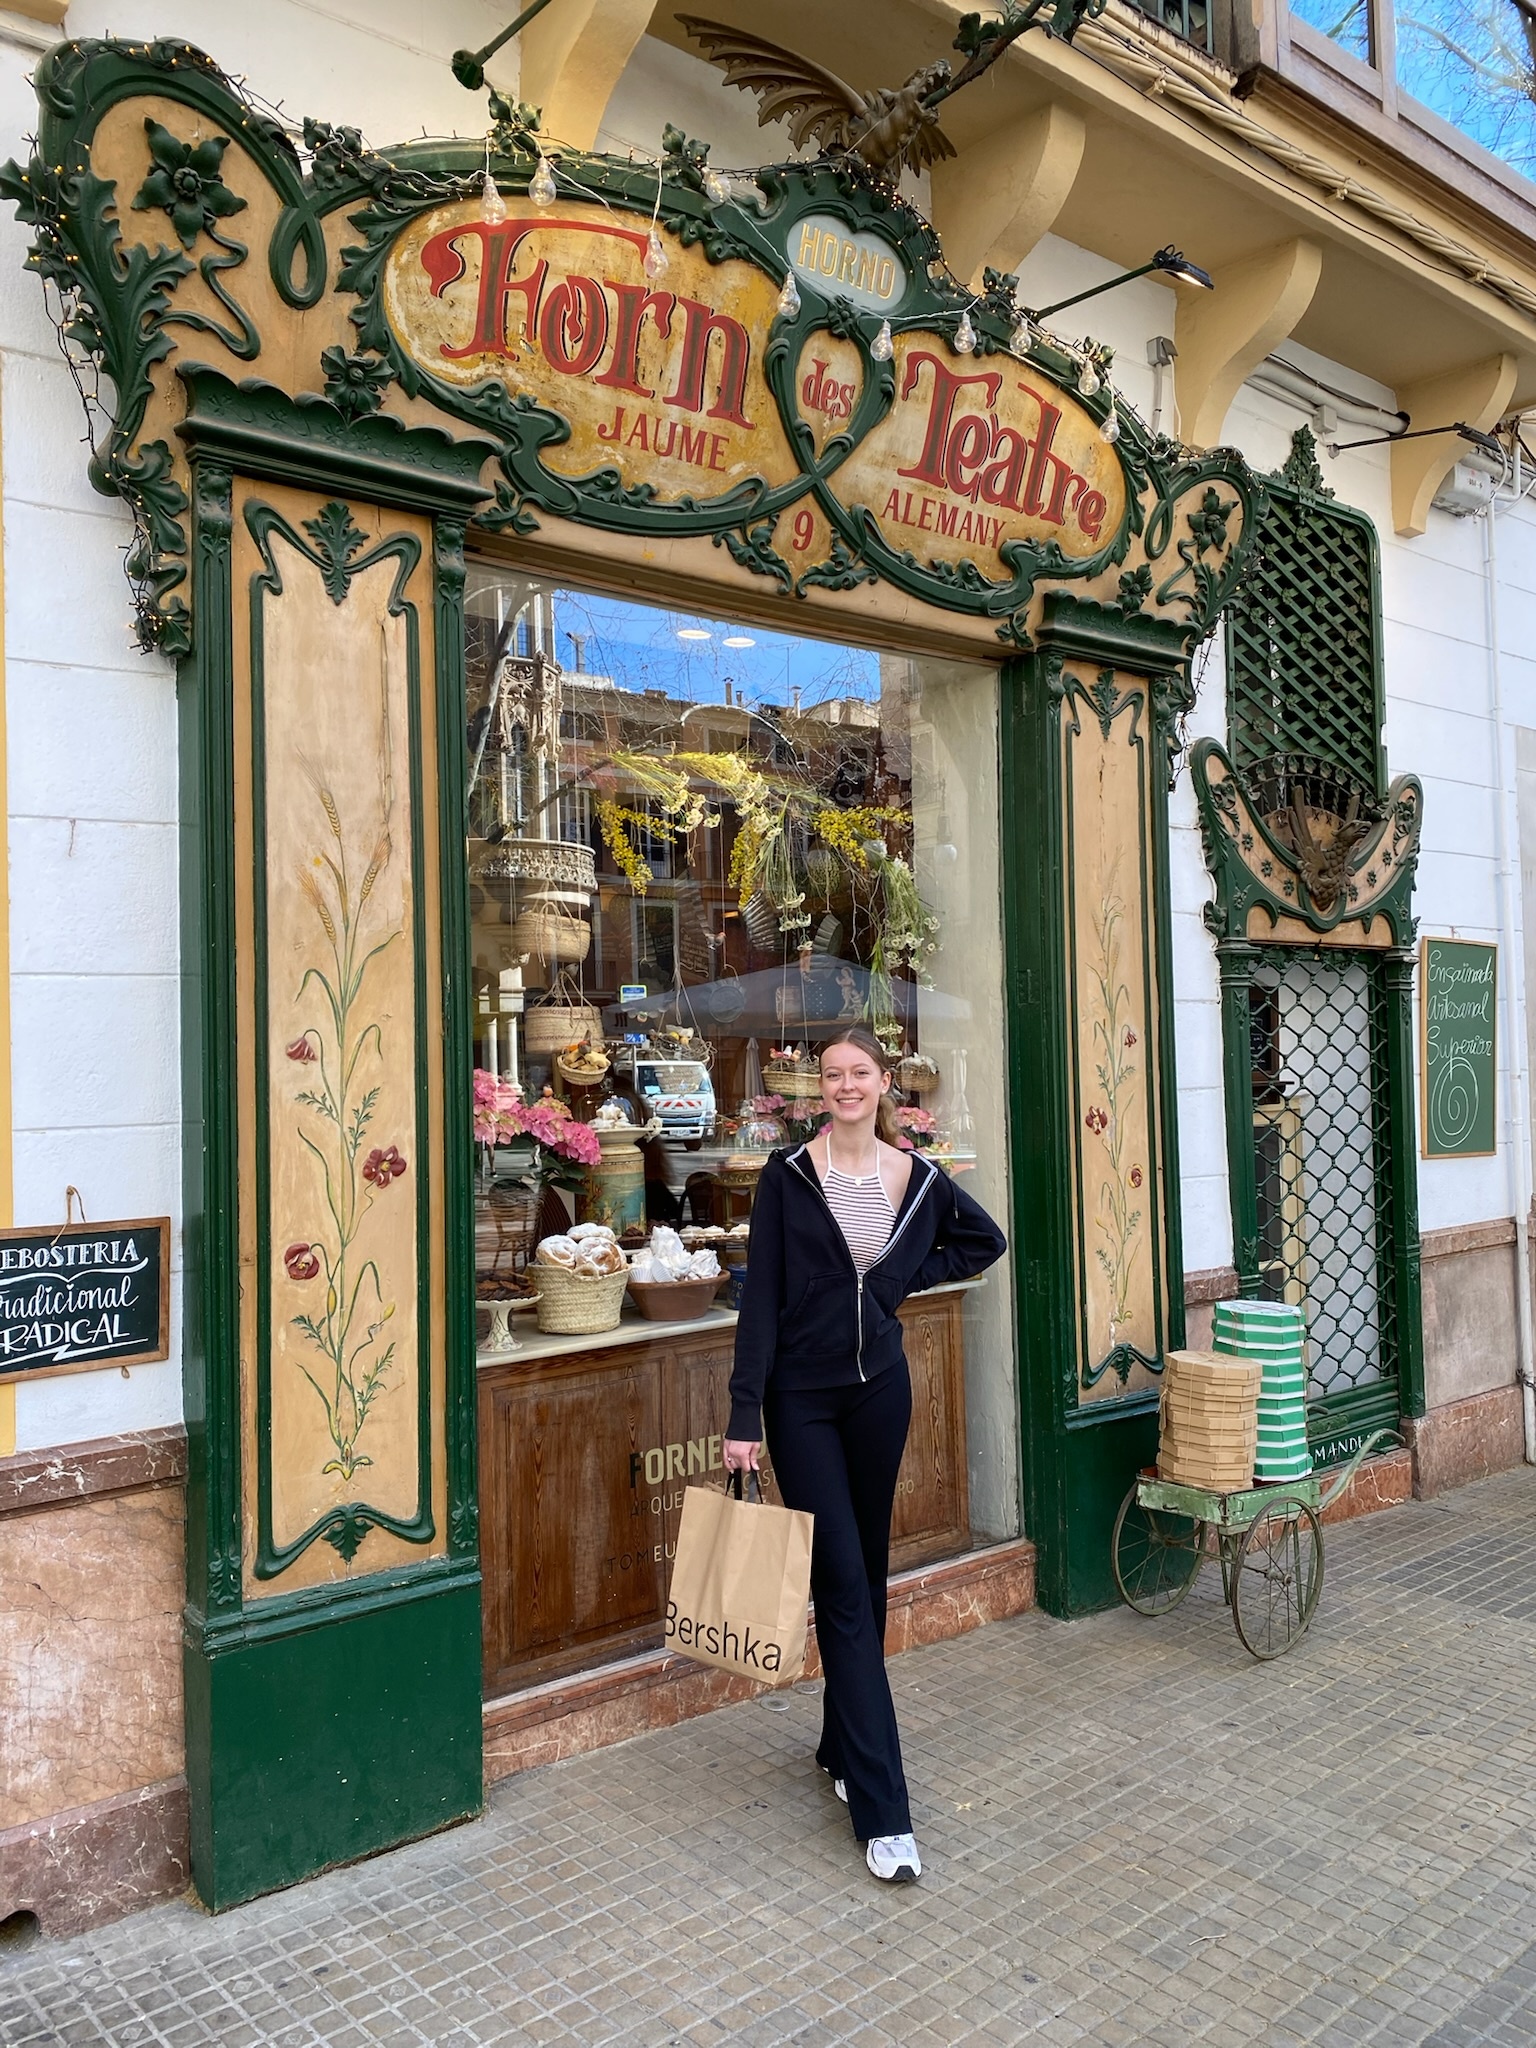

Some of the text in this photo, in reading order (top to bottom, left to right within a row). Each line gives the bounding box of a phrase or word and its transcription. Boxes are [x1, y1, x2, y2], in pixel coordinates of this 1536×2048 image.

[796, 221, 897, 300] HORNO
[420, 218, 1108, 543] Forn des Teatre
[597, 405, 731, 473] JAUME
[792, 510, 816, 552] 9
[880, 489, 1004, 550] ALEMANY
[0, 1238, 140, 1272] EBOSTERIA
[0, 1313, 130, 1354] RADICAL
[629, 1433, 726, 1489] FORNE
[631, 1490, 683, 1517] ARQUE
[665, 1600, 782, 1672] Bershka
